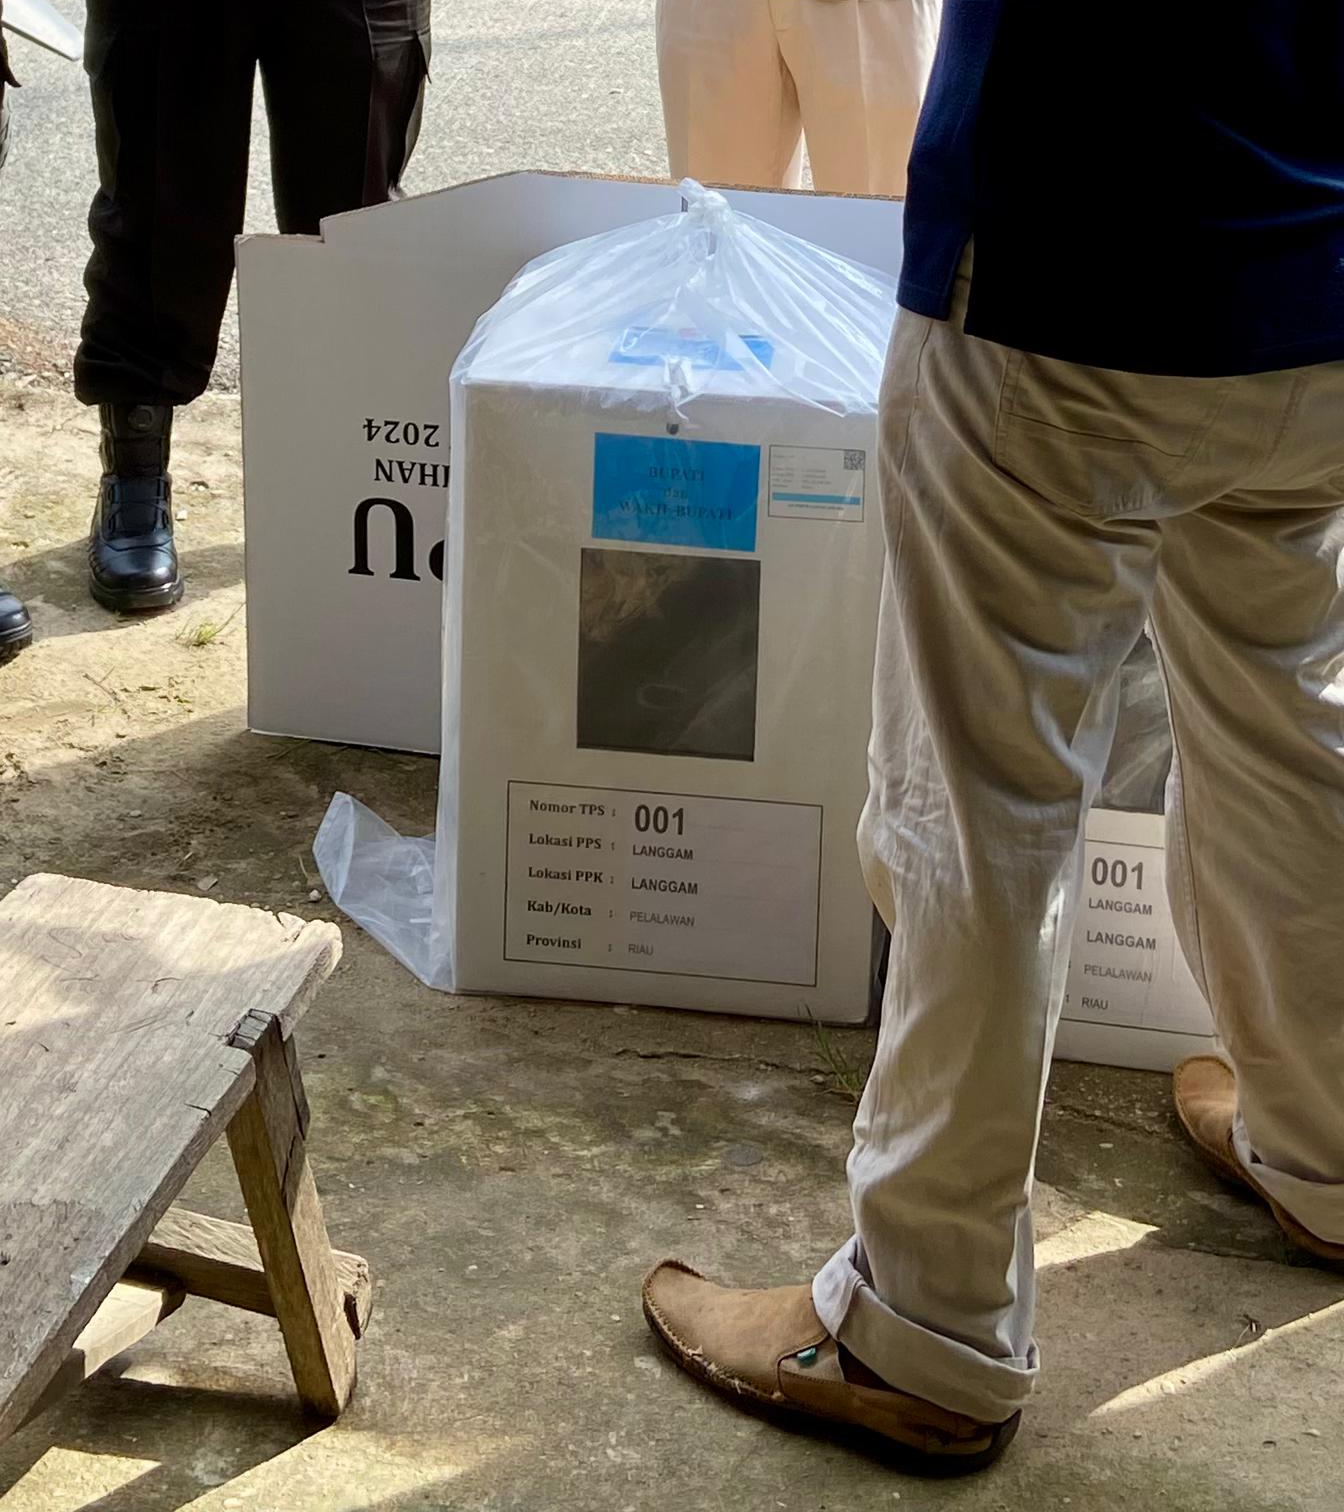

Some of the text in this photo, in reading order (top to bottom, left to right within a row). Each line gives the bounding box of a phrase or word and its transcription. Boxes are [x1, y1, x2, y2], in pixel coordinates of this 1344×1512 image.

[362, 418, 440, 448] 2024
[374, 458, 450, 488] IHAN
[529, 799, 577, 815] Nomor
[578, 803, 606, 817] TPS
[634, 803, 685, 836] 001
[528, 833, 573, 848] Lokasi
[576, 836, 602, 850] PPS
[632, 844, 694, 861] LANGGAM
[528, 866, 572, 882] Lokasi
[575, 870, 604, 884] PPK
[631, 877, 698, 895] LANGGAM
[1091, 857, 1144, 891] 001
[527, 900, 592, 916] Kab/Kota
[629, 911, 696, 927] PELALAWAN
[1088, 897, 1153, 916] LANGGAM
[526, 934, 582, 950] Provinsi
[628, 943, 655, 956] RIAU
[1086, 930, 1157, 951] LANGGAM
[1083, 963, 1153, 984] PELALAWAN
[1081, 996, 1109, 1010] RIAU
